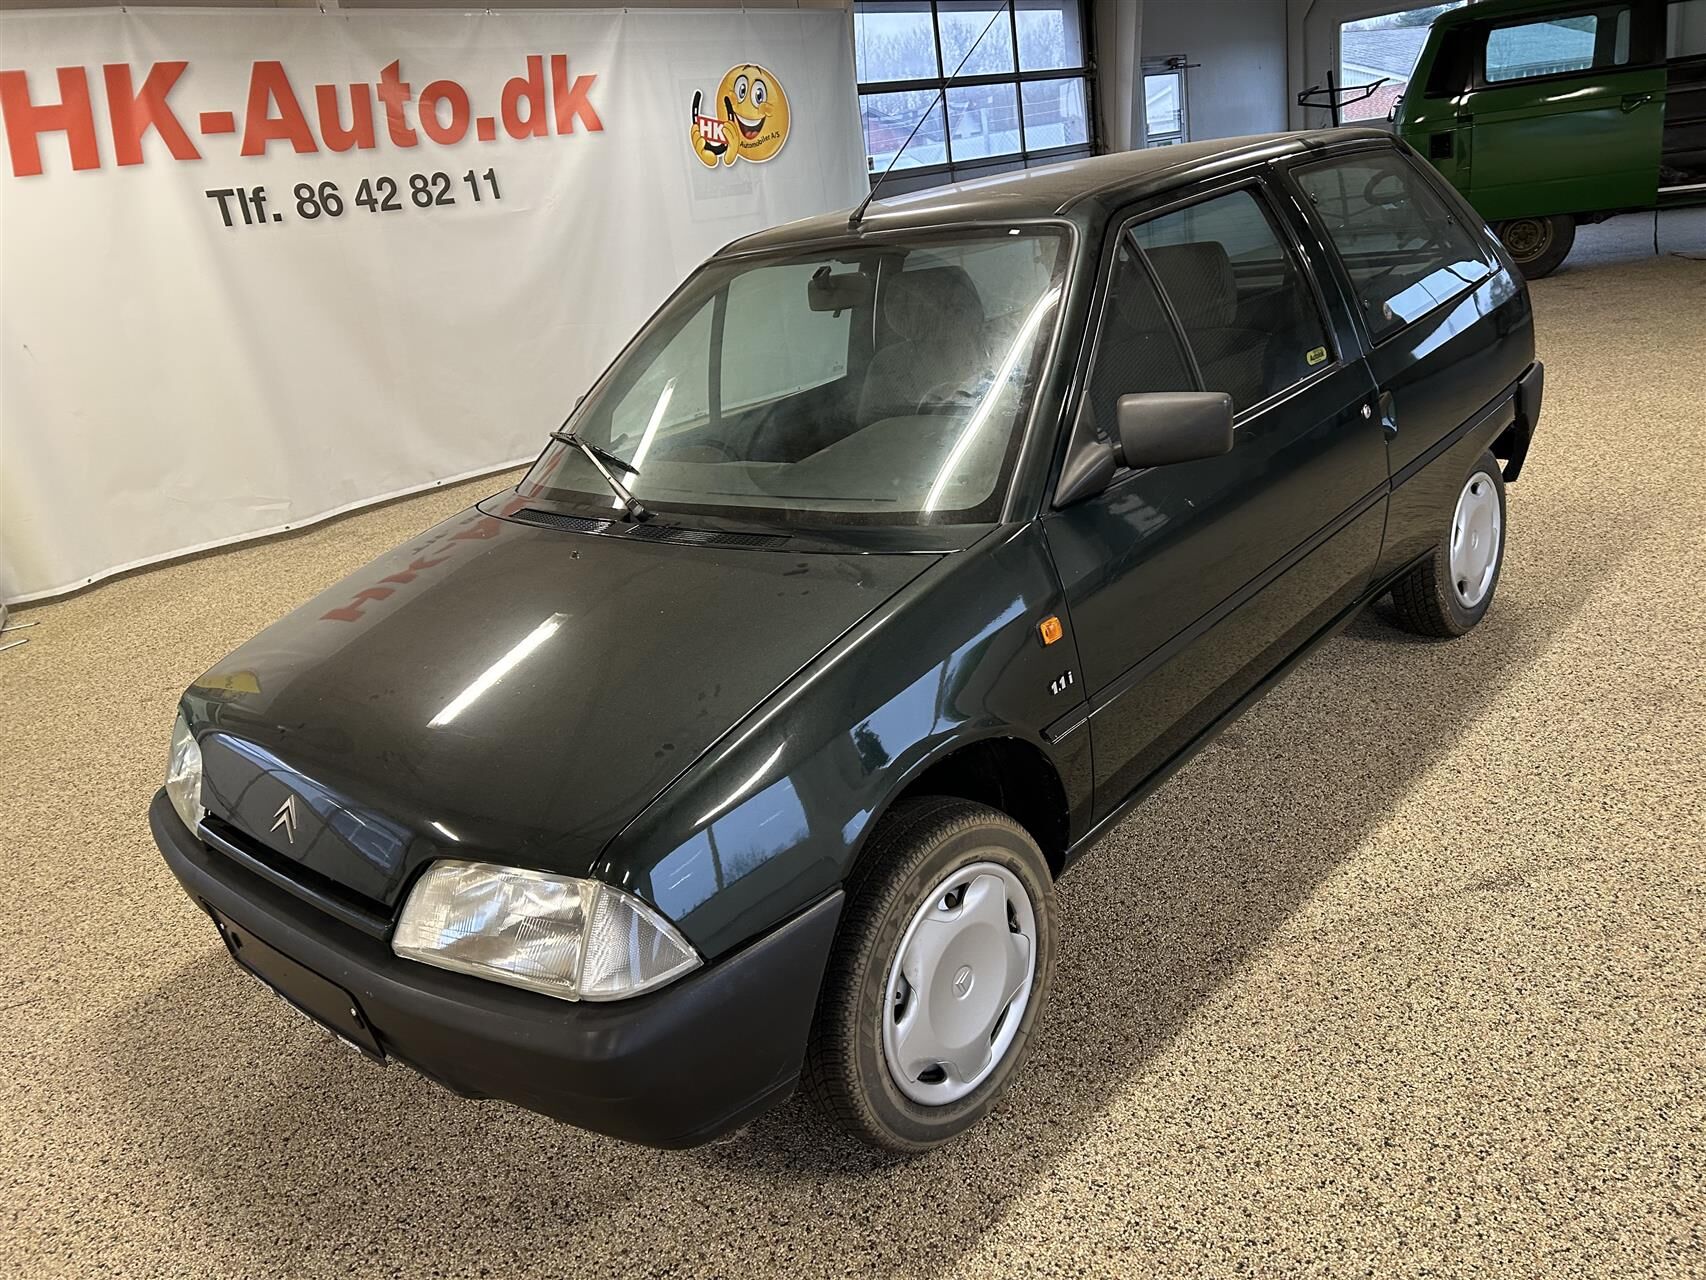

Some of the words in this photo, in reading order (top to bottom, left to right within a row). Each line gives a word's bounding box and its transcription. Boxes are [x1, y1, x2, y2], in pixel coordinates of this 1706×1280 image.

[0, 54, 604, 177] HK-Auto.dk
[700, 119, 726, 142] HK
[740, 135, 770, 149] Automobiler
[771, 131, 780, 139] A/S
[205, 186, 283, 227] Tlf.
[293, 181, 344, 220] 86
[355, 176, 402, 213] 42
[409, 172, 456, 208] 82
[463, 168, 501, 202] 11
